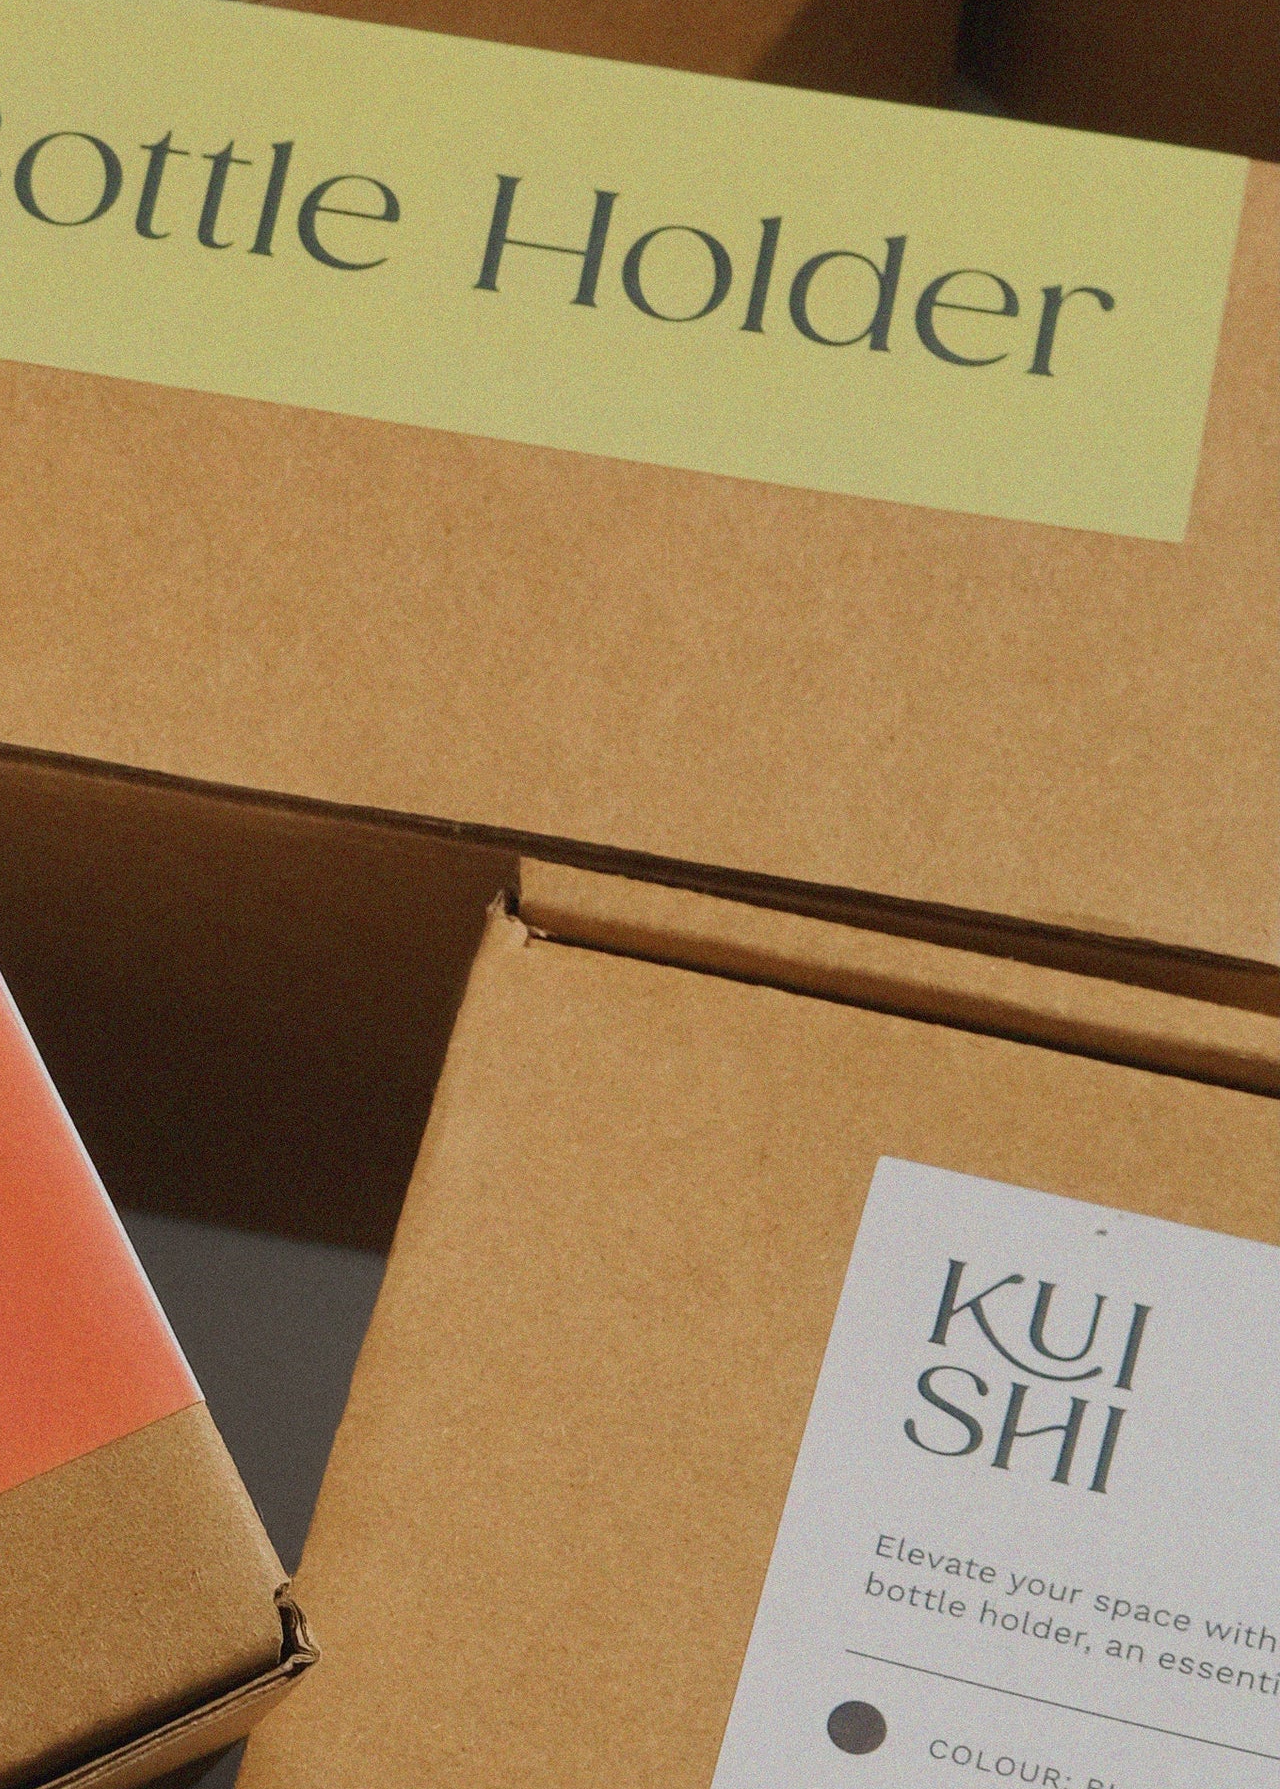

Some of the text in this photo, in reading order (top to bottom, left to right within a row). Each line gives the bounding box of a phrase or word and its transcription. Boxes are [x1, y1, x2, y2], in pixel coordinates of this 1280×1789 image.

[474, 174, 1115, 377] Holder
[929, 1259, 1151, 1390] KUI
[904, 1366, 1125, 1494] SHI
[864, 1570, 967, 1619] bottle
[978, 1593, 1092, 1656] holder,
[1104, 1638, 1145, 1665] an
[874, 1533, 1278, 1654] Elevate your space with
